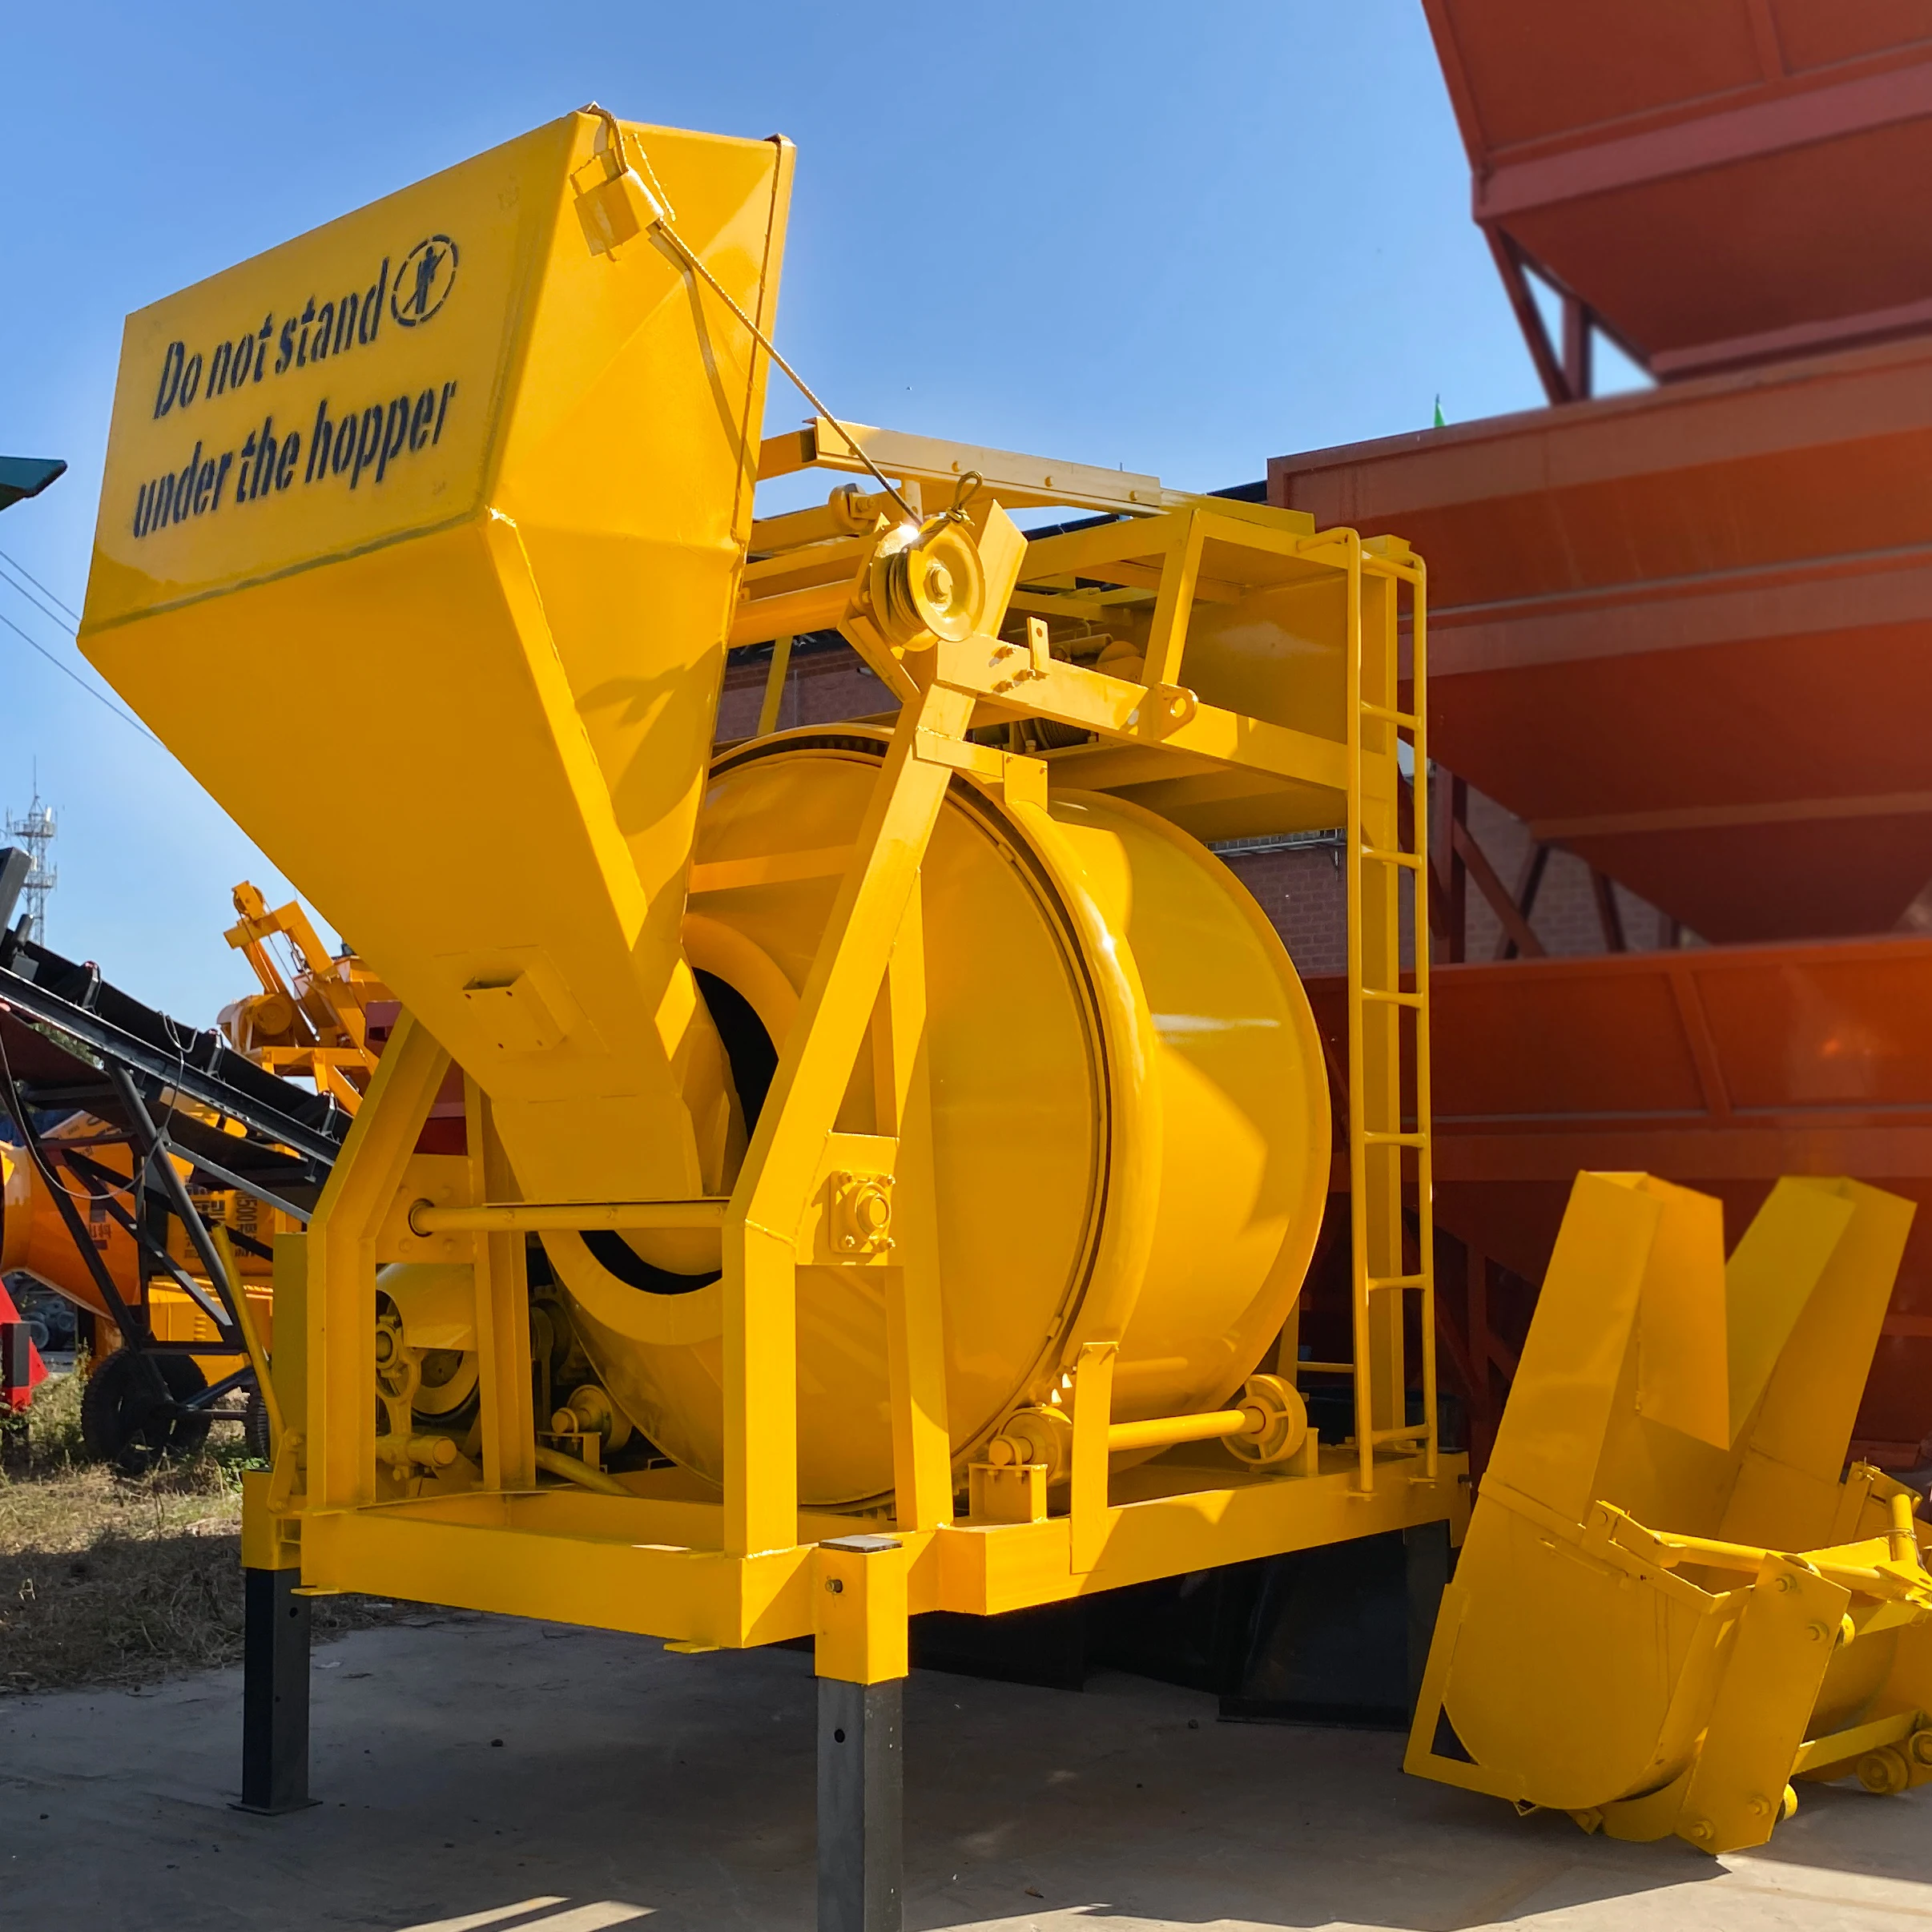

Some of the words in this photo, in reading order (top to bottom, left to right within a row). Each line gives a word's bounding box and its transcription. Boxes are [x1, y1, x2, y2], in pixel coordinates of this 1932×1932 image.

[153, 340, 203, 421] Do
[205, 312, 273, 400] not
[275, 257, 391, 375] stand
[133, 441, 234, 539] under
[235, 416, 301, 504] the
[304, 380, 459, 491] hopper
